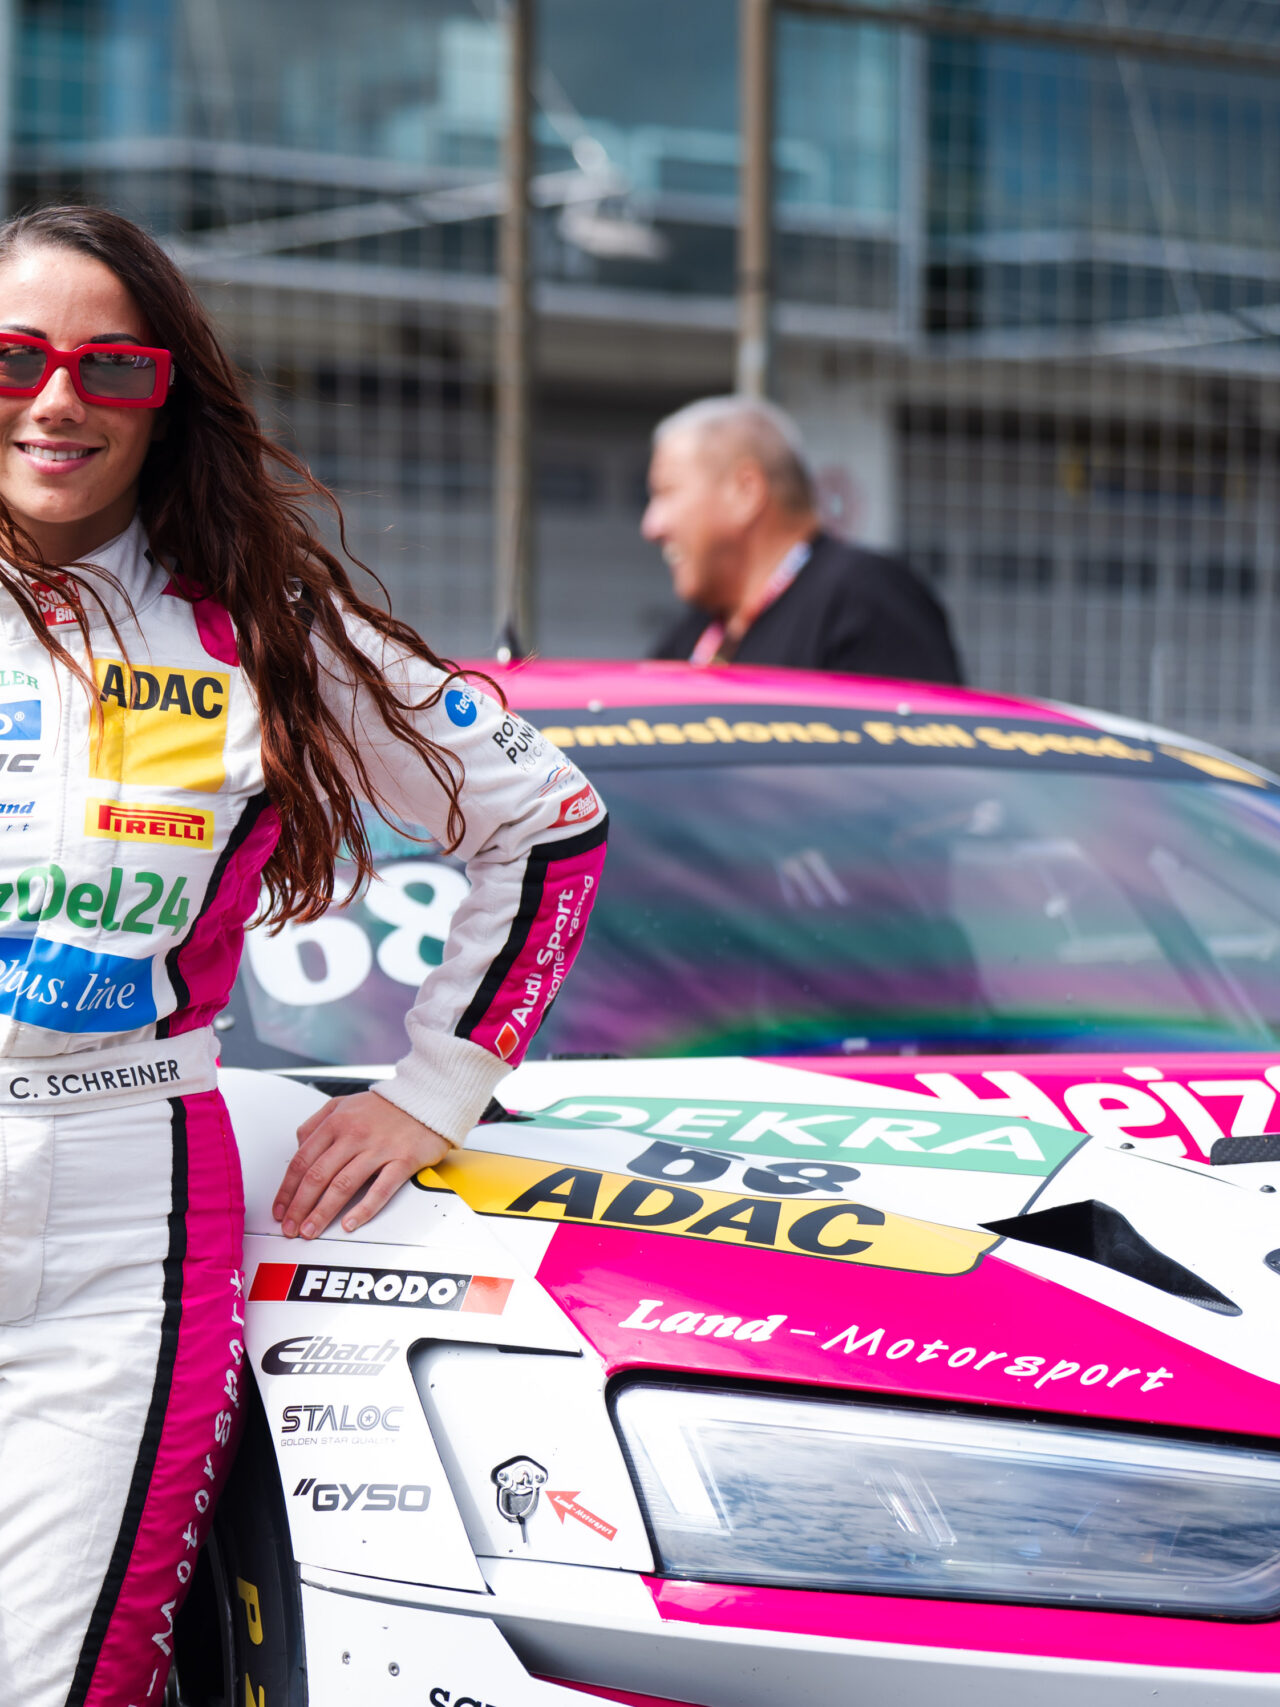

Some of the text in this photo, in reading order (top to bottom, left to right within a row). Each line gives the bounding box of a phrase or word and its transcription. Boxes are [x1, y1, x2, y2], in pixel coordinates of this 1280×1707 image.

[100, 663, 225, 719] ADAC
[97, 804, 205, 841] PIRELLI
[246, 861, 471, 1007] 68
[512, 888, 574, 1028] Audi Sport
[9, 1059, 181, 1099] C. SCHREINER
[547, 1103, 1046, 1162] DEKRA
[505, 1167, 886, 1256] ADAC
[261, 1335, 401, 1376] Eibach
[618, 1298, 788, 1343] Land
[821, 1323, 1174, 1393] Motorsport
[281, 1404, 405, 1433] STALOC
[281, 1438, 318, 1446] GOLDEN
[352, 1436, 397, 1444] QUALITY
